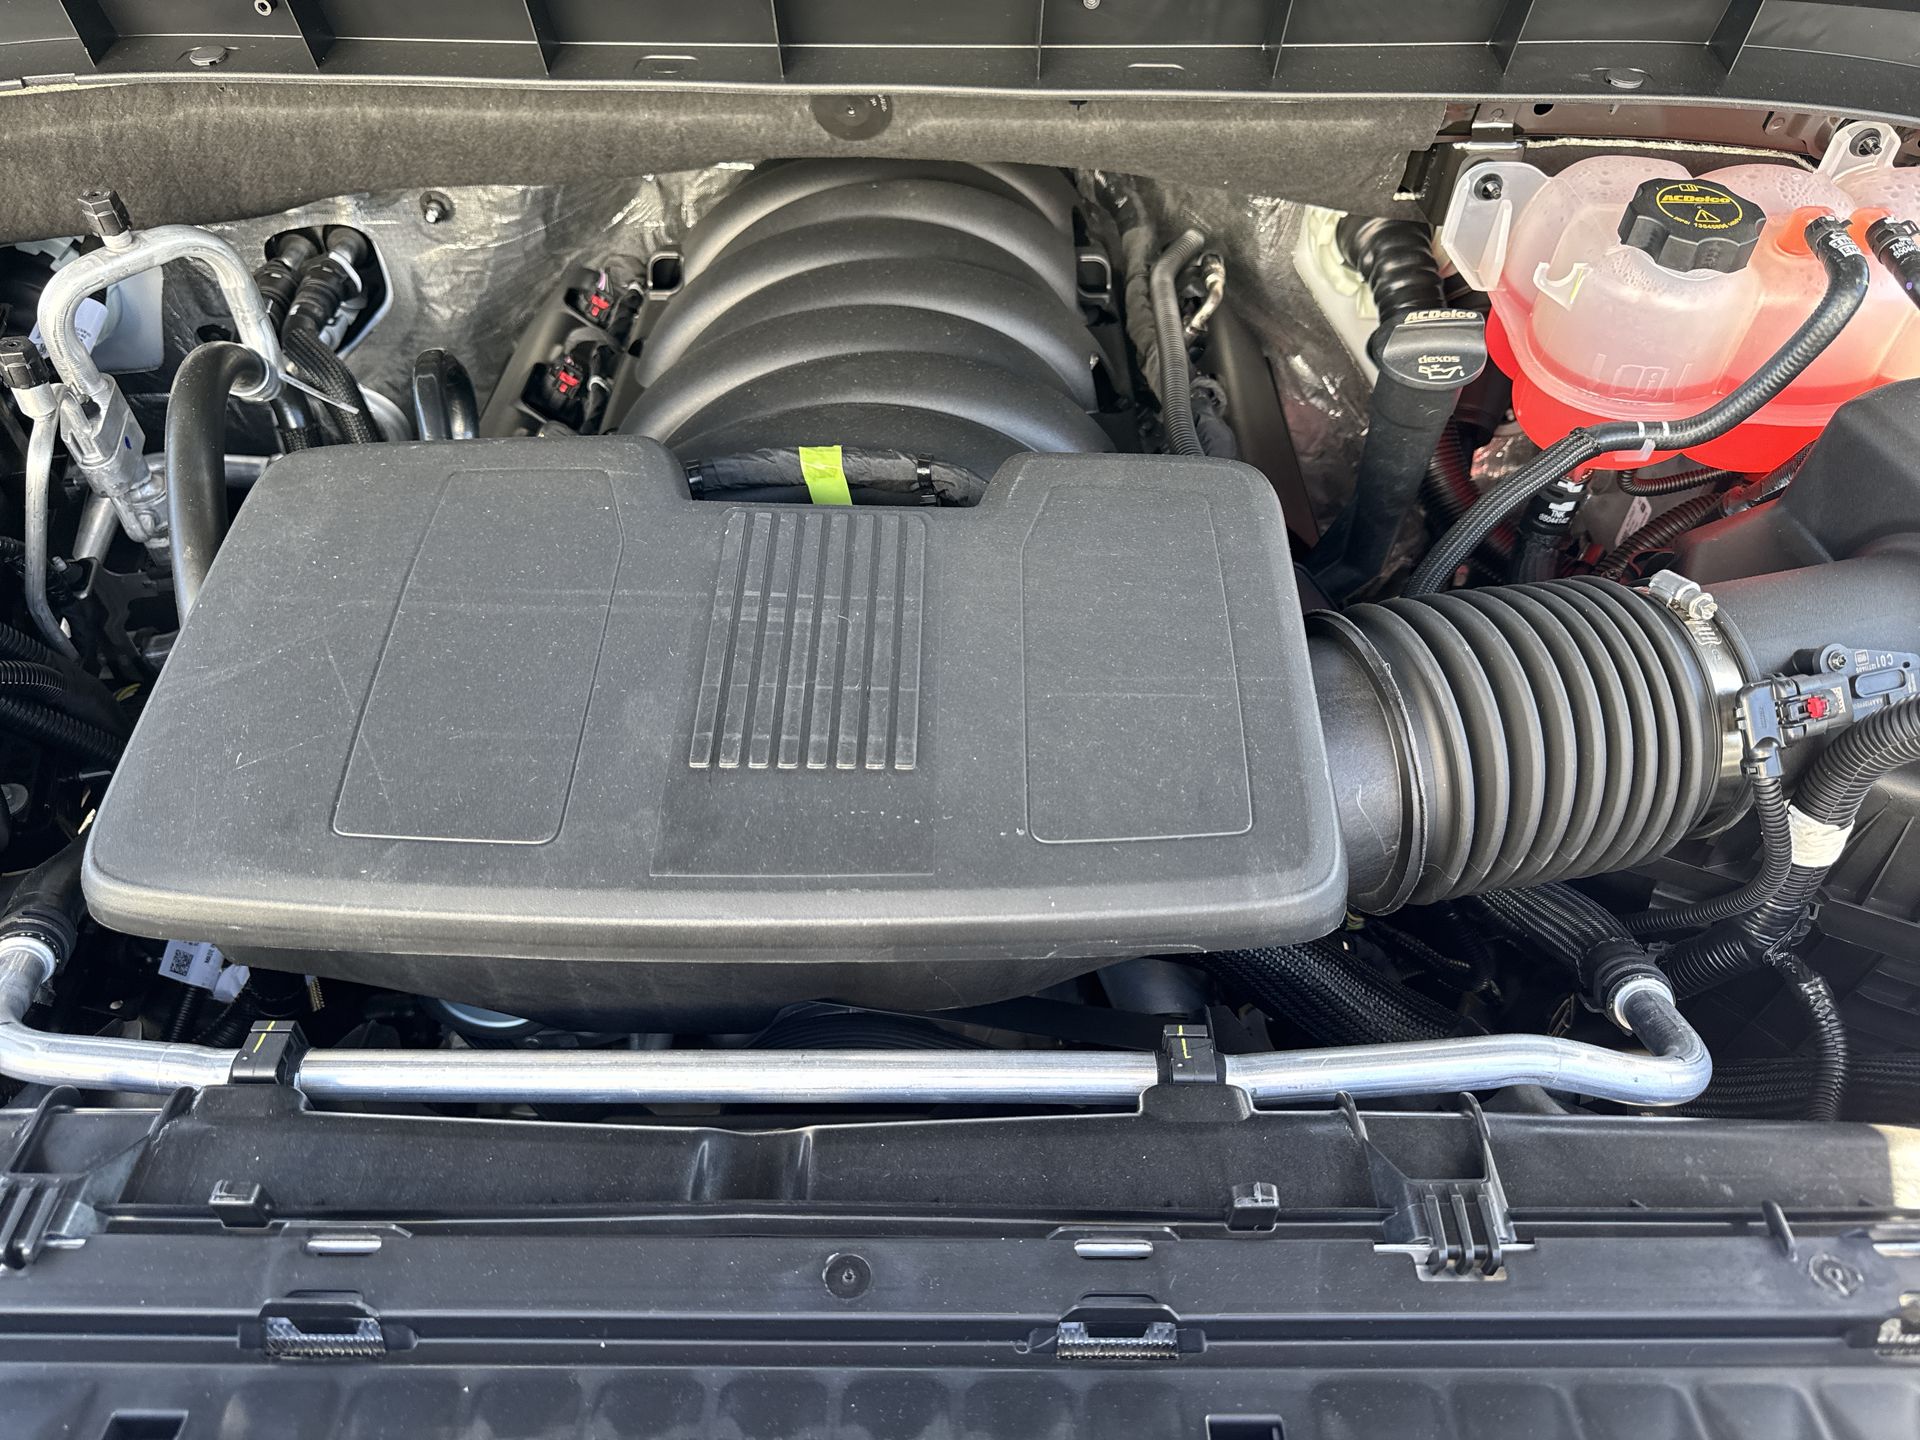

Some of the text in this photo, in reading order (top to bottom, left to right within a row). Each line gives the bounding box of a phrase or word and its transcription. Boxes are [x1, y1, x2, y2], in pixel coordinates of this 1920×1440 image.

[1660, 194, 1732, 204] ACDelco
[1404, 310, 1477, 323] ACDelco
[1418, 355, 1460, 364] dexos
